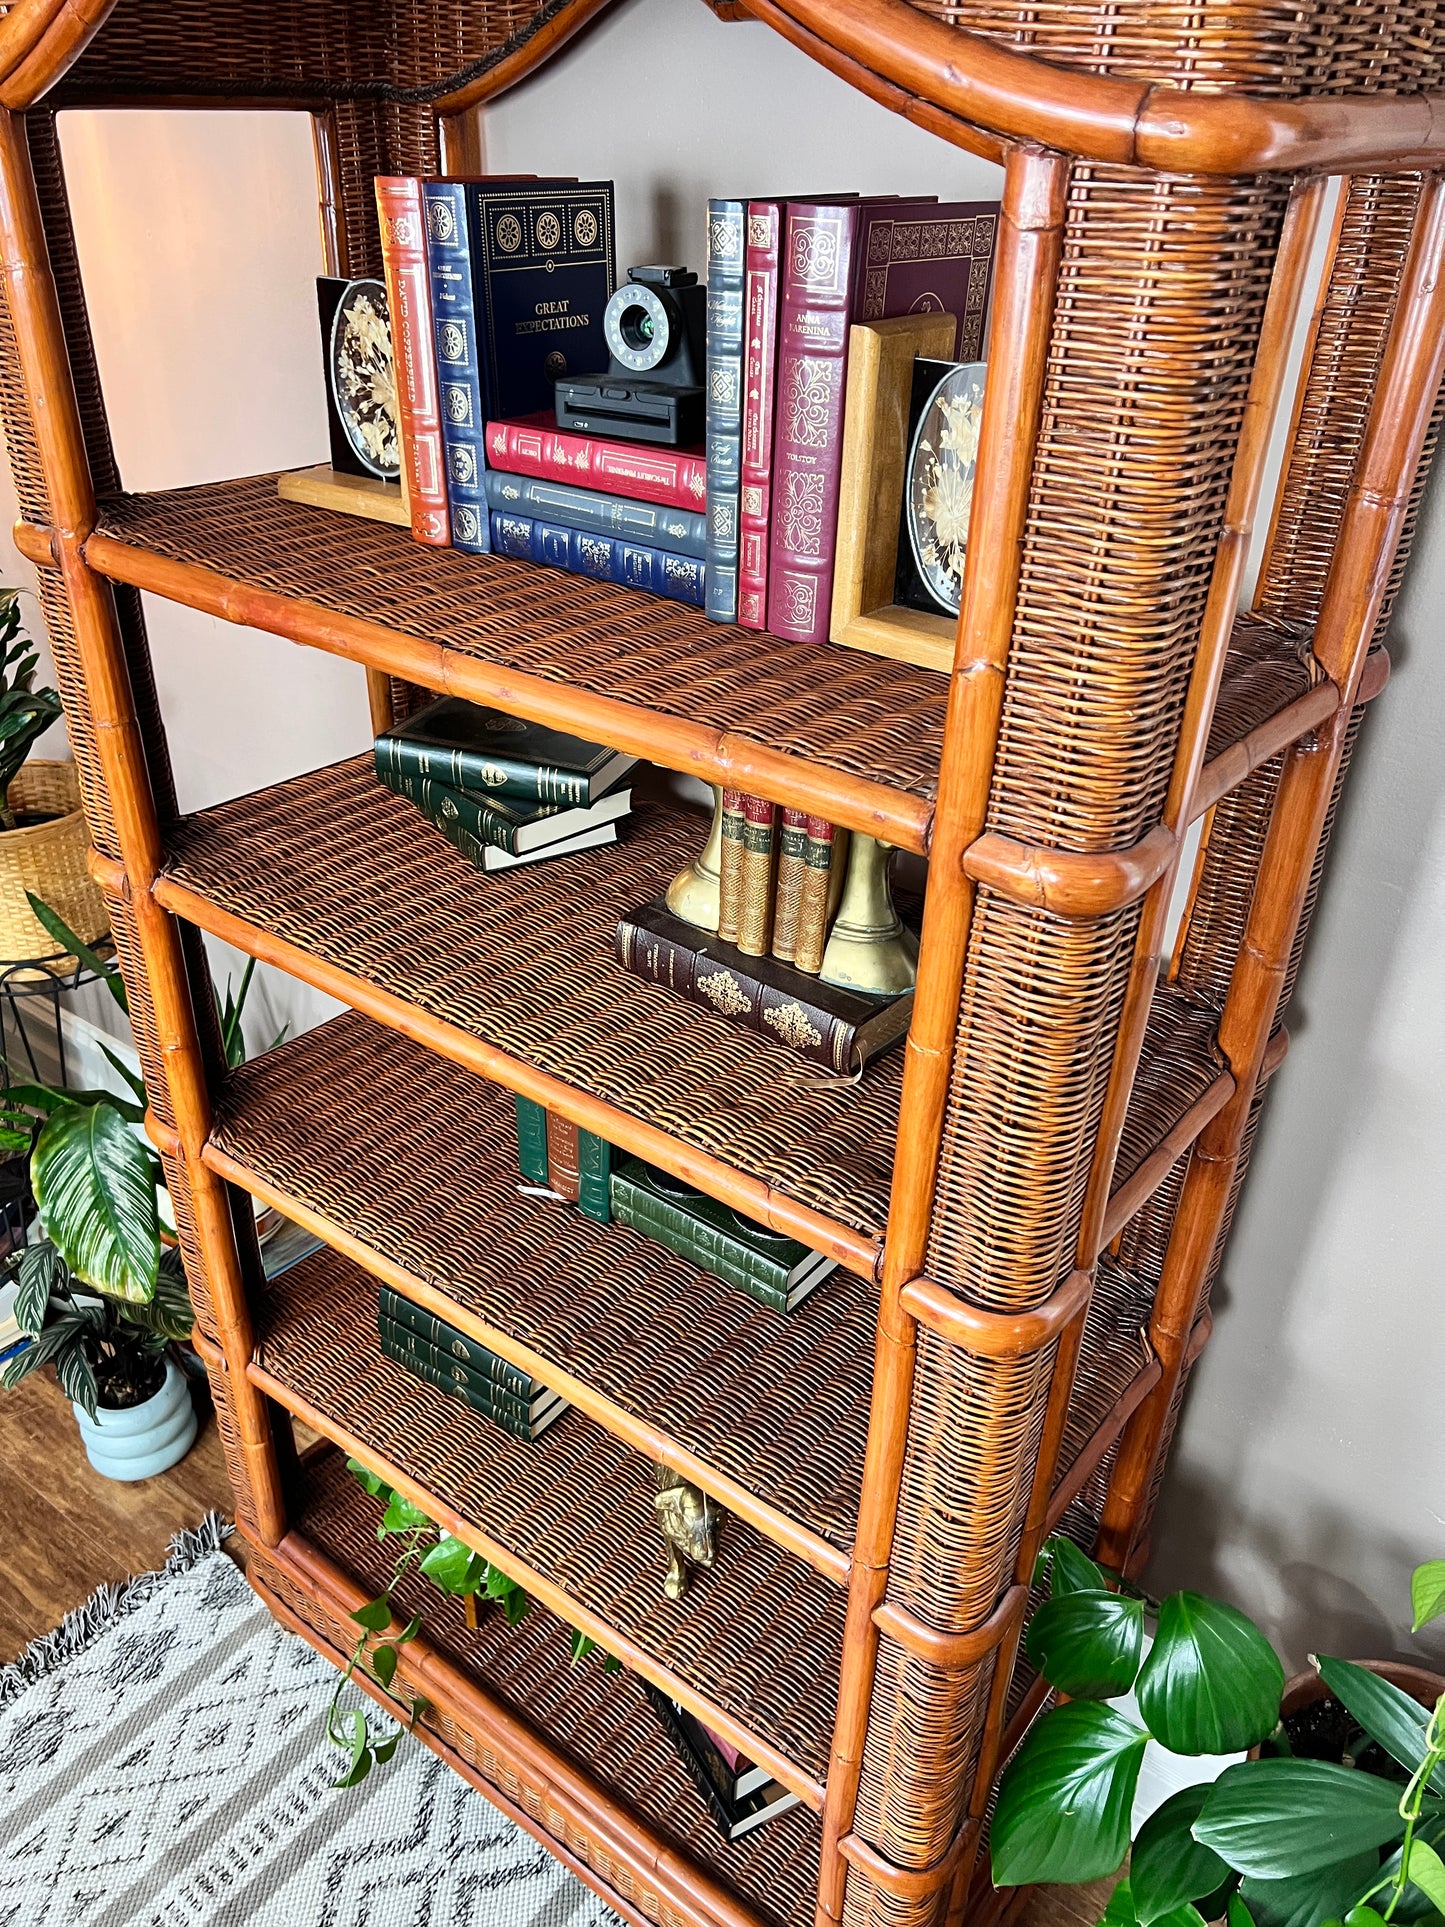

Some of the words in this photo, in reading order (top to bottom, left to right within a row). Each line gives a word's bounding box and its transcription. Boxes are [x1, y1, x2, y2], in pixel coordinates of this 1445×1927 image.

[535, 300, 569, 315] GREAT
[515, 314, 589, 334] EXPECTATIONS
[796, 314, 821, 325] ANNA
[786, 452, 818, 465] TOLSTOY
